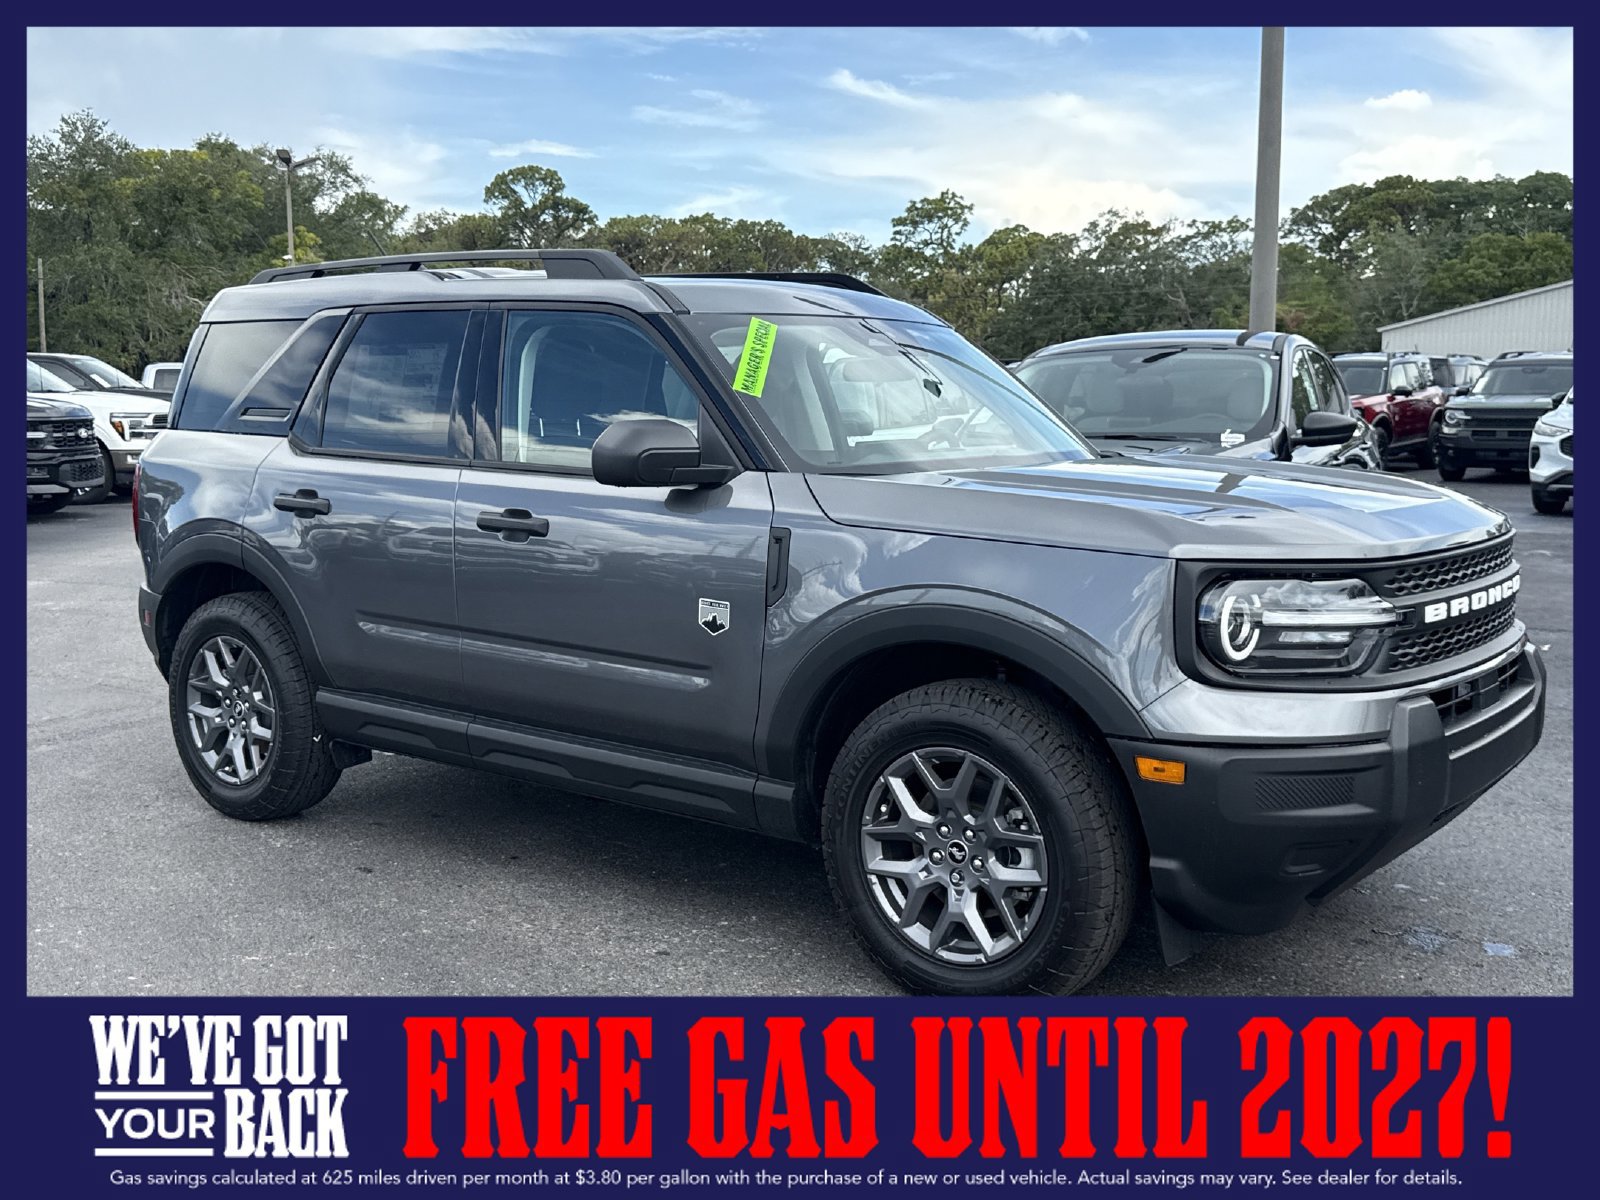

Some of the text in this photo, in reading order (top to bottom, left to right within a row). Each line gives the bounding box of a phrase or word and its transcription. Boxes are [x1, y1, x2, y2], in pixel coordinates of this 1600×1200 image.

[740, 320, 772, 394] MANAGER'S SPECIAL
[1424, 574, 1520, 624] BRONCO
